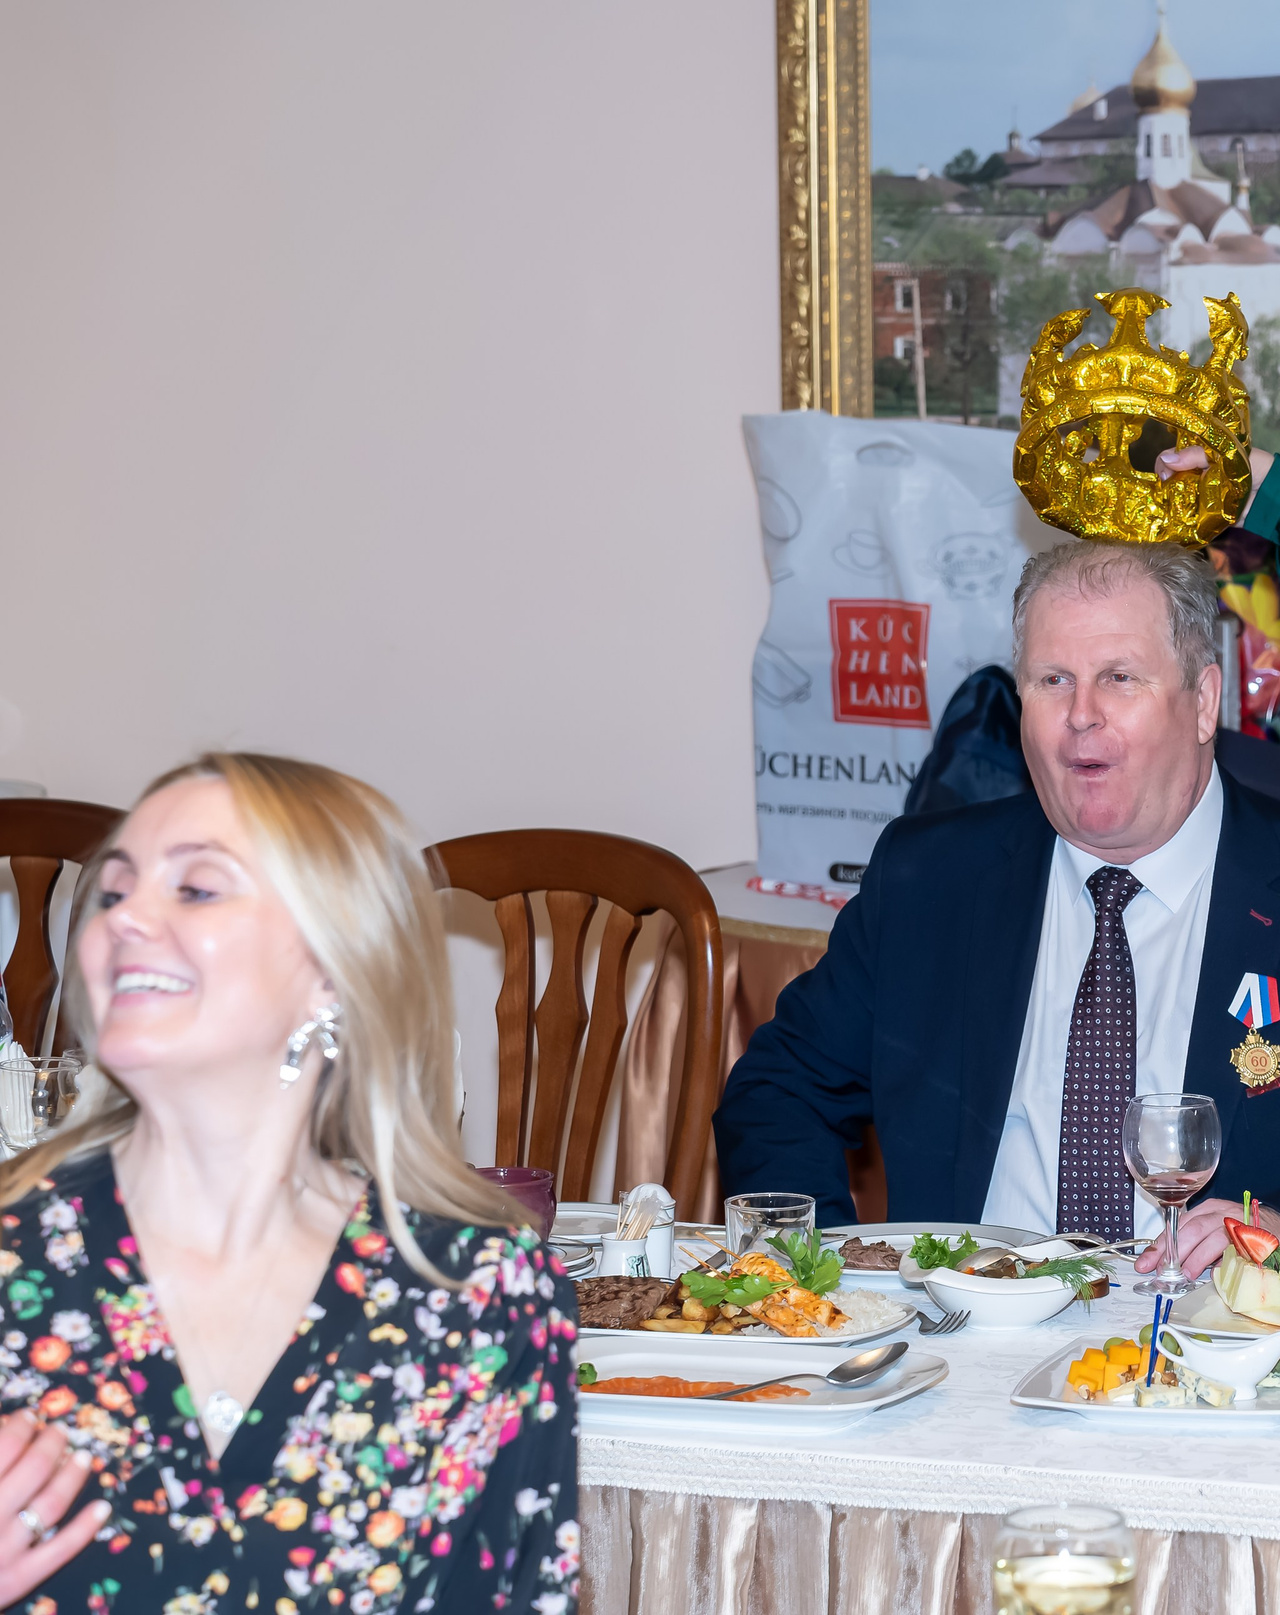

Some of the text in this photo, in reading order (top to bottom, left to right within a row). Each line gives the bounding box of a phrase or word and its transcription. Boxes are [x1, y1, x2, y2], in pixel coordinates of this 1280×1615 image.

[848, 649, 919, 676] HEN
[850, 681, 922, 709] LAND
[755, 744, 918, 786] ÜCHENLAN
[778, 804, 847, 819] магазинов
[1251, 1056, 1267, 1067] 60
